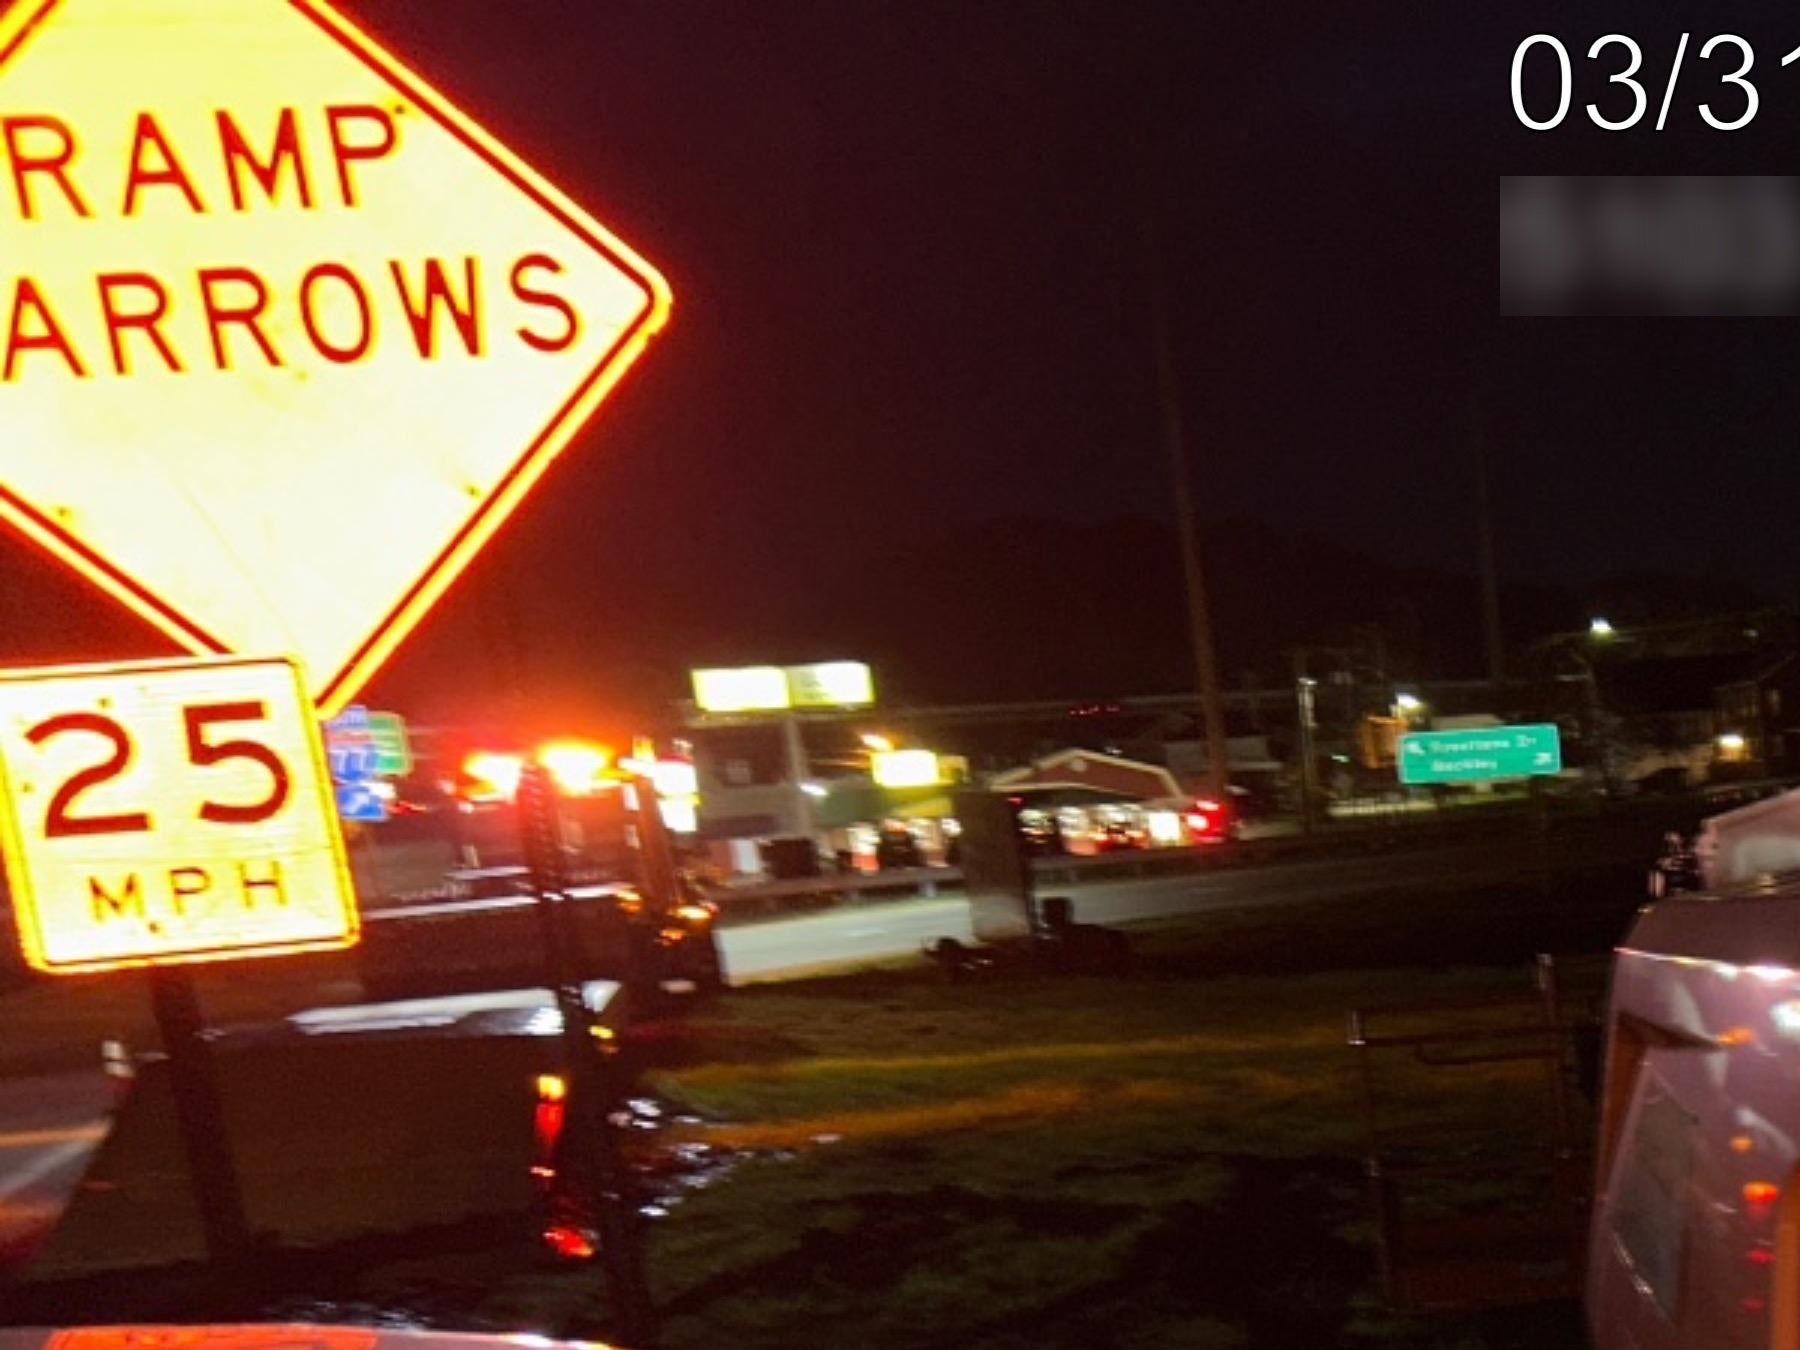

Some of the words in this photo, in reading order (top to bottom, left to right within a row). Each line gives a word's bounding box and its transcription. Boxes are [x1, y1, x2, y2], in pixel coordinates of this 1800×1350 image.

[1, 104, 397, 220] RAMP
[25, 701, 289, 838] 25
[89, 861, 289, 922] MPH
